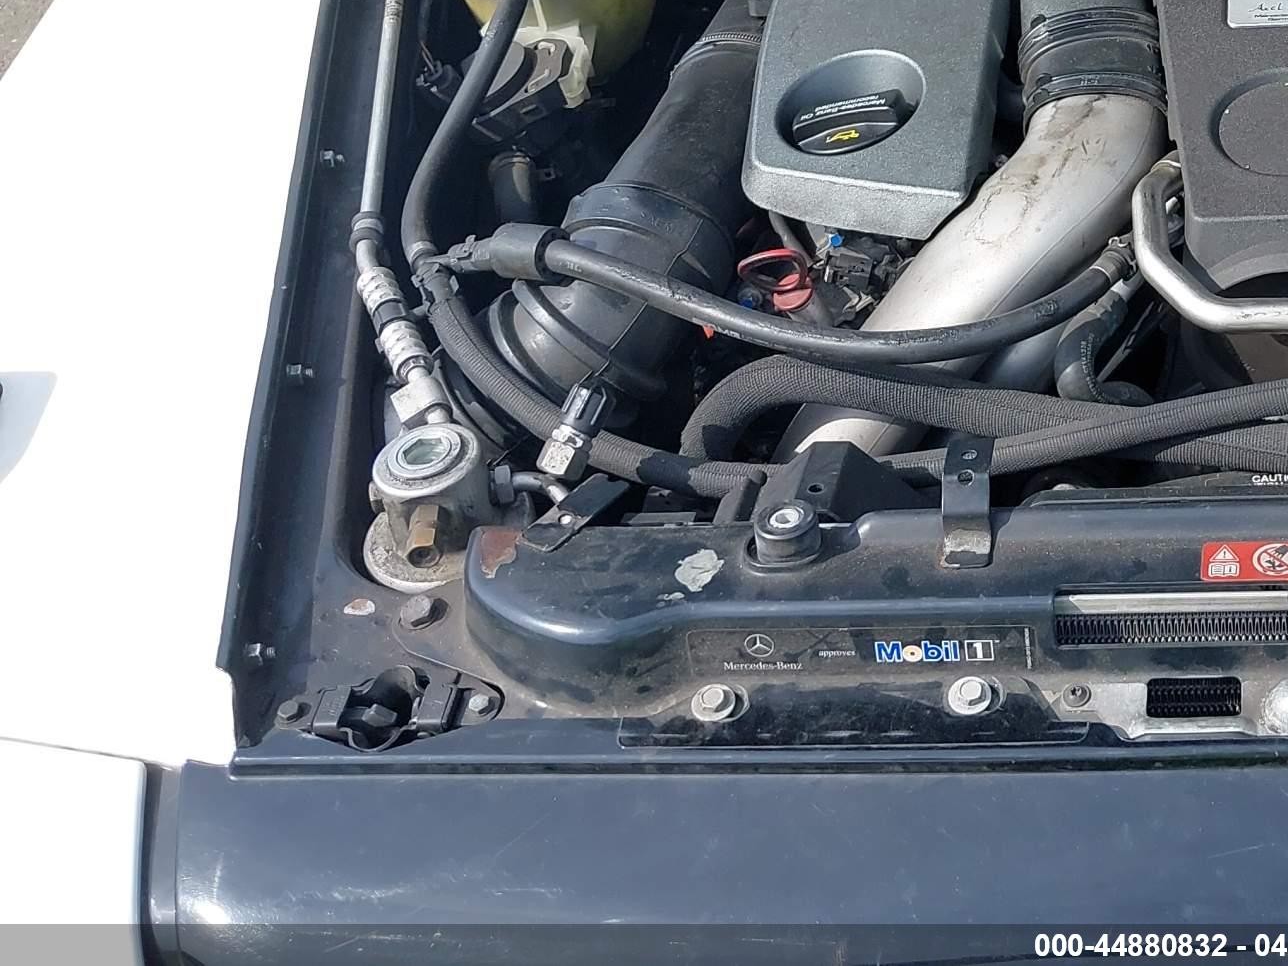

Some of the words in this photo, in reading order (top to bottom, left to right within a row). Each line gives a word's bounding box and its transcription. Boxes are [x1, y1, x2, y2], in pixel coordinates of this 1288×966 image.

[815, 99, 885, 115] Mercedes-Benz
[818, 649, 856, 657] approves
[874, 640, 961, 663] Mobil
[723, 661, 803, 671] Mercedes-Benz
